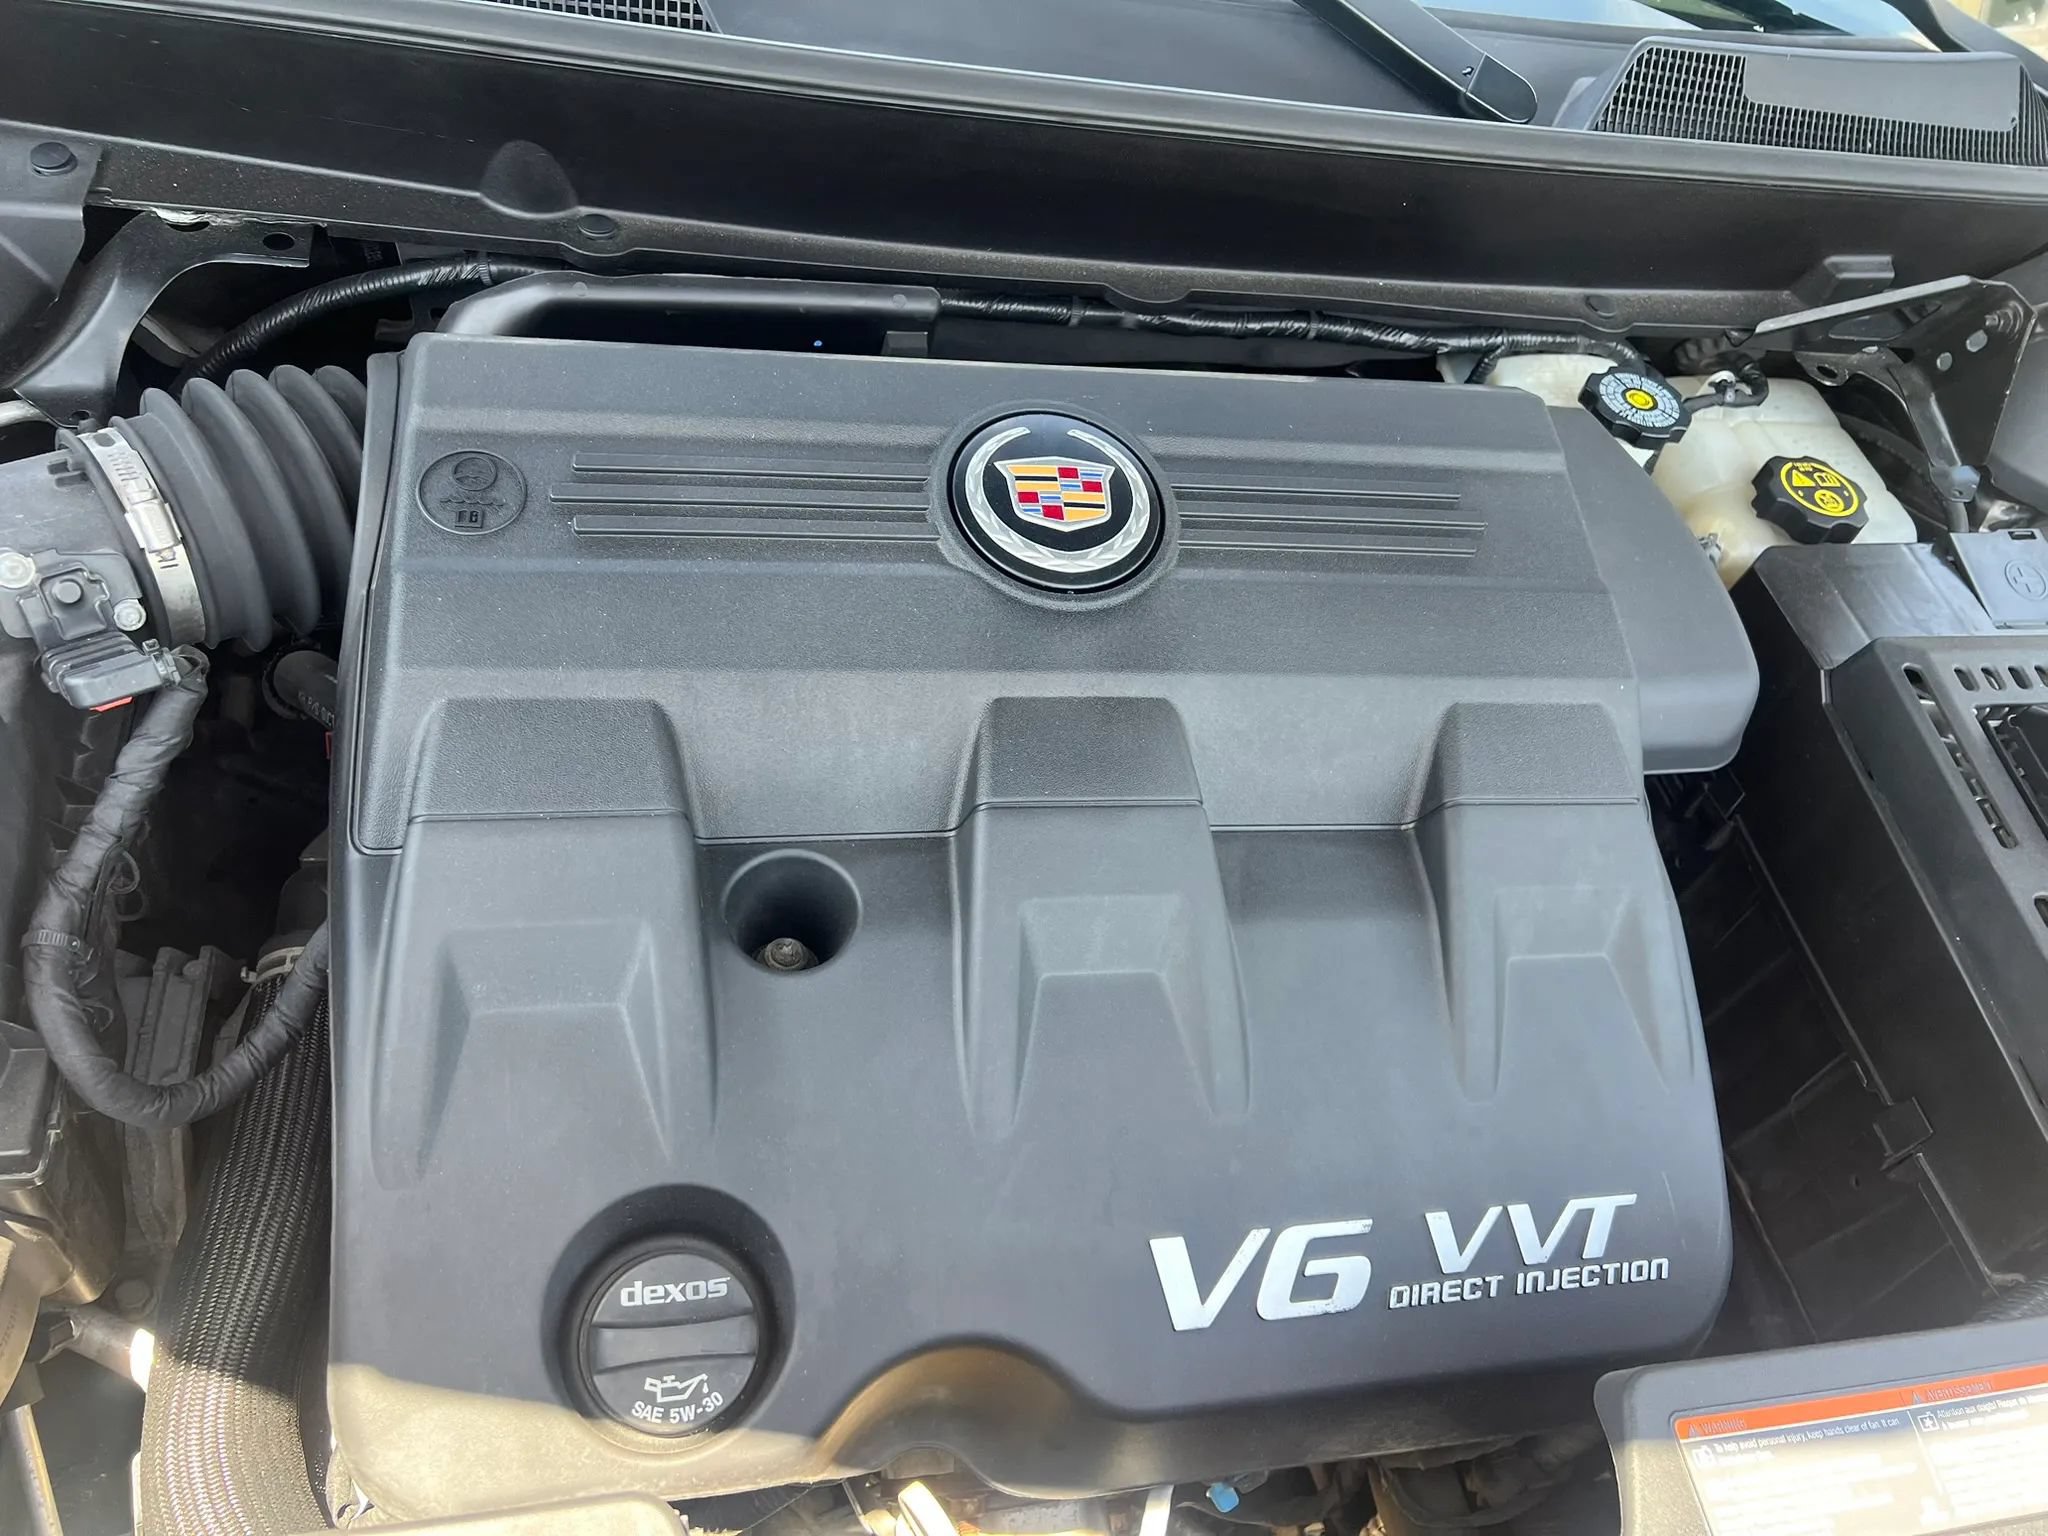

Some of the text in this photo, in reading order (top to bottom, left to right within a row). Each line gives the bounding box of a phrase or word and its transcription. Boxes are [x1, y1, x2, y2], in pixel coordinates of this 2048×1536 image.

[1425, 1193, 1638, 1274] VVT
[620, 1276, 731, 1307] dexos
[1149, 1218, 1373, 1332] V6
[1388, 1257, 1670, 1311] DIRECT INJECTION
[631, 1391, 724, 1424] SAE 5W-30
[1758, 1435, 1786, 1448] personal
[1823, 1425, 1845, 1437] hands
[1844, 1422, 1861, 1434] clear
[1887, 1418, 1900, 1427] can
